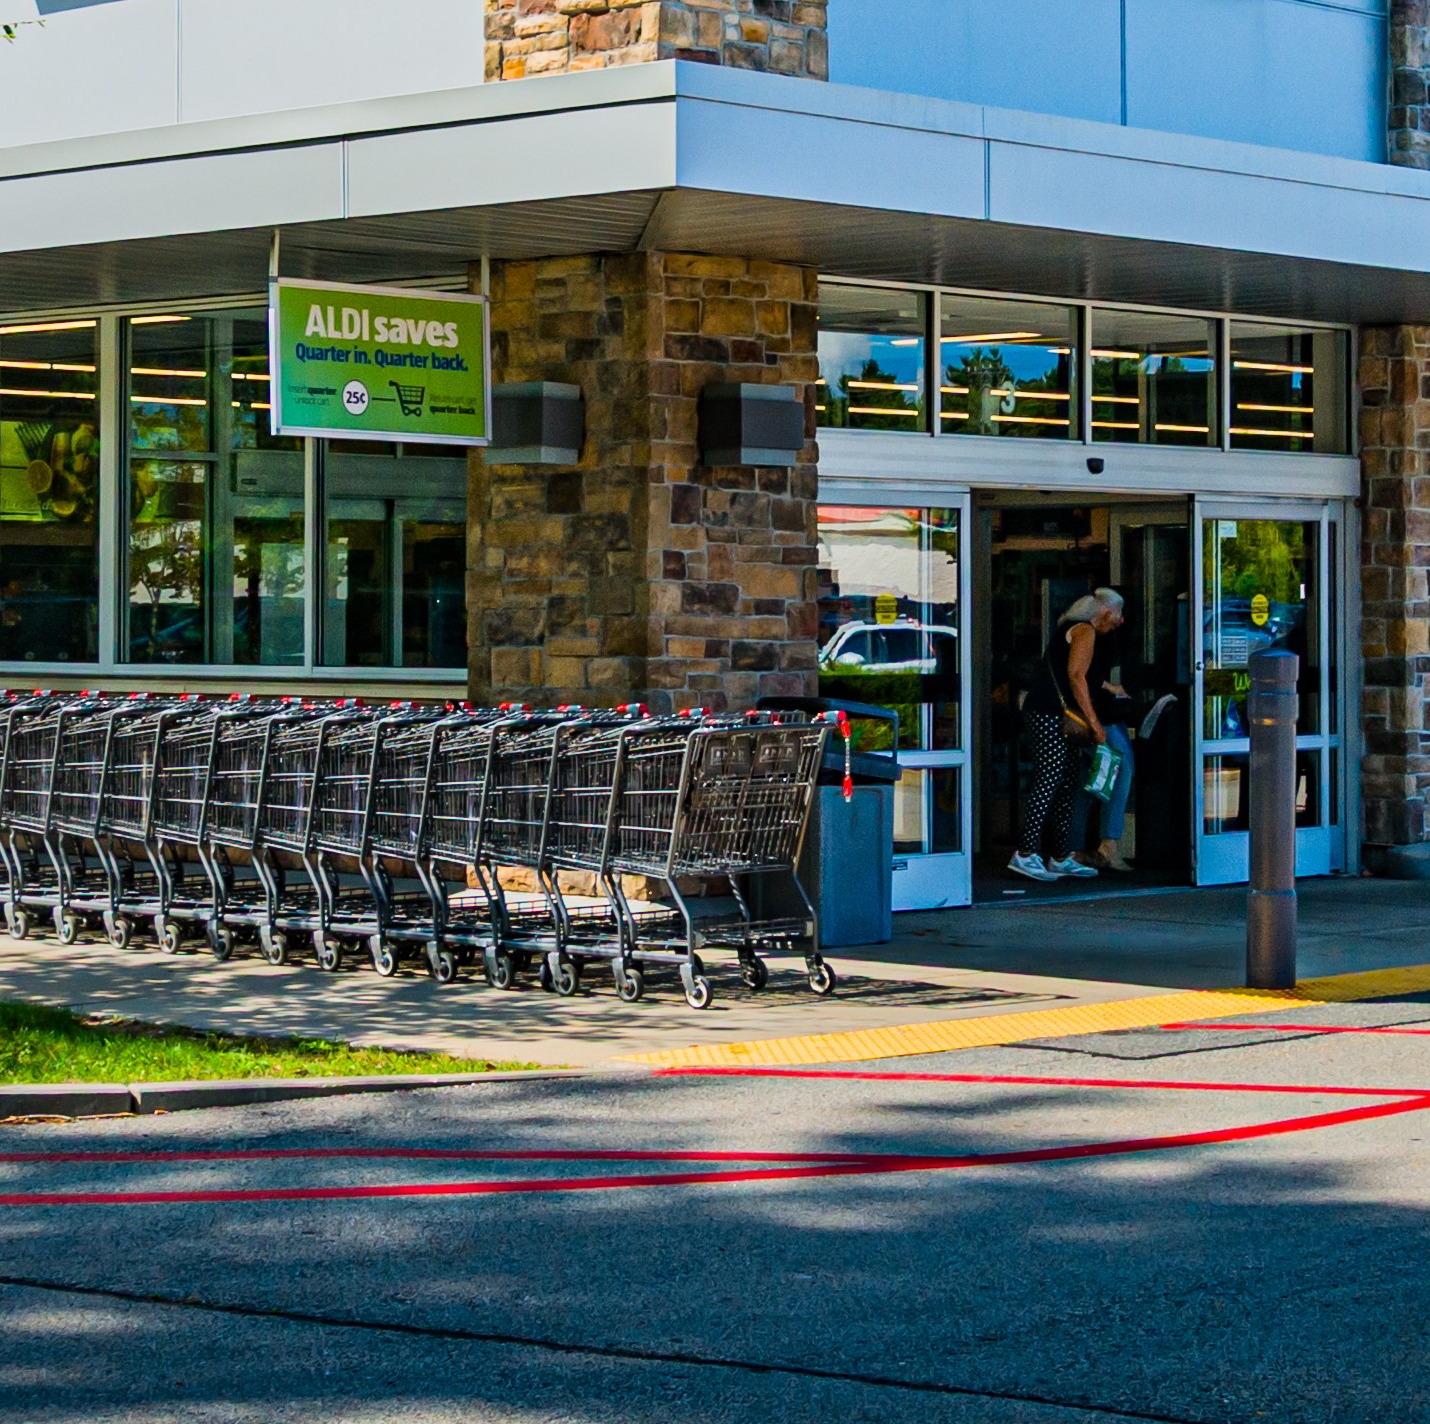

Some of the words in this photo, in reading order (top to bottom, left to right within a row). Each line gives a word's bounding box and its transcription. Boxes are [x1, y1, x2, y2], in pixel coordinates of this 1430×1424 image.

[305, 304, 370, 341] ALDI
[374, 316, 459, 348] saves
[295, 343, 352, 363] Quarter
[354, 345, 372, 364] in.
[374, 349, 429, 368] Quarter
[431, 352, 469, 371] back.
[346, 391, 366, 404] 25¢
